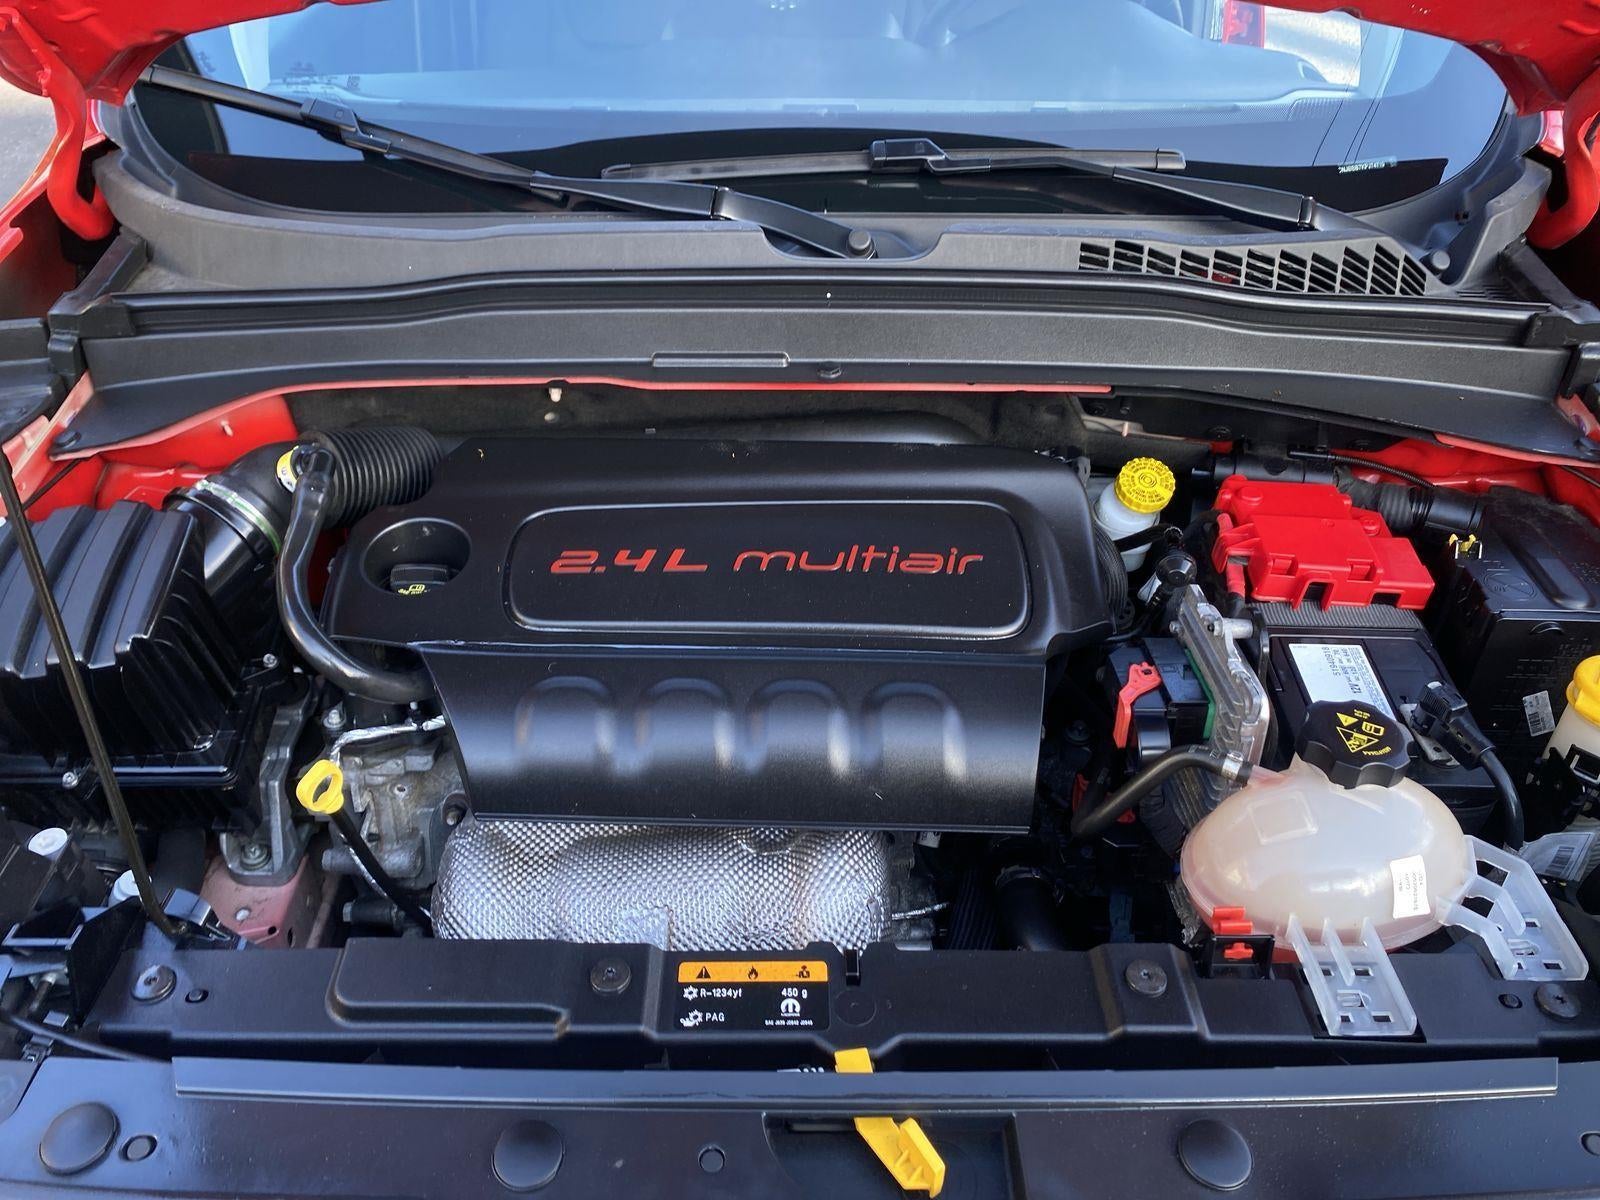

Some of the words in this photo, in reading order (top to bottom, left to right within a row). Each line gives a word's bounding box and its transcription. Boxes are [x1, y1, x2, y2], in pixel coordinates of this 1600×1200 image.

[733, 544, 984, 576] multiair
[781, 987, 798, 997] 450
[801, 988, 808, 999] g
[705, 1012, 725, 1022] PAG
